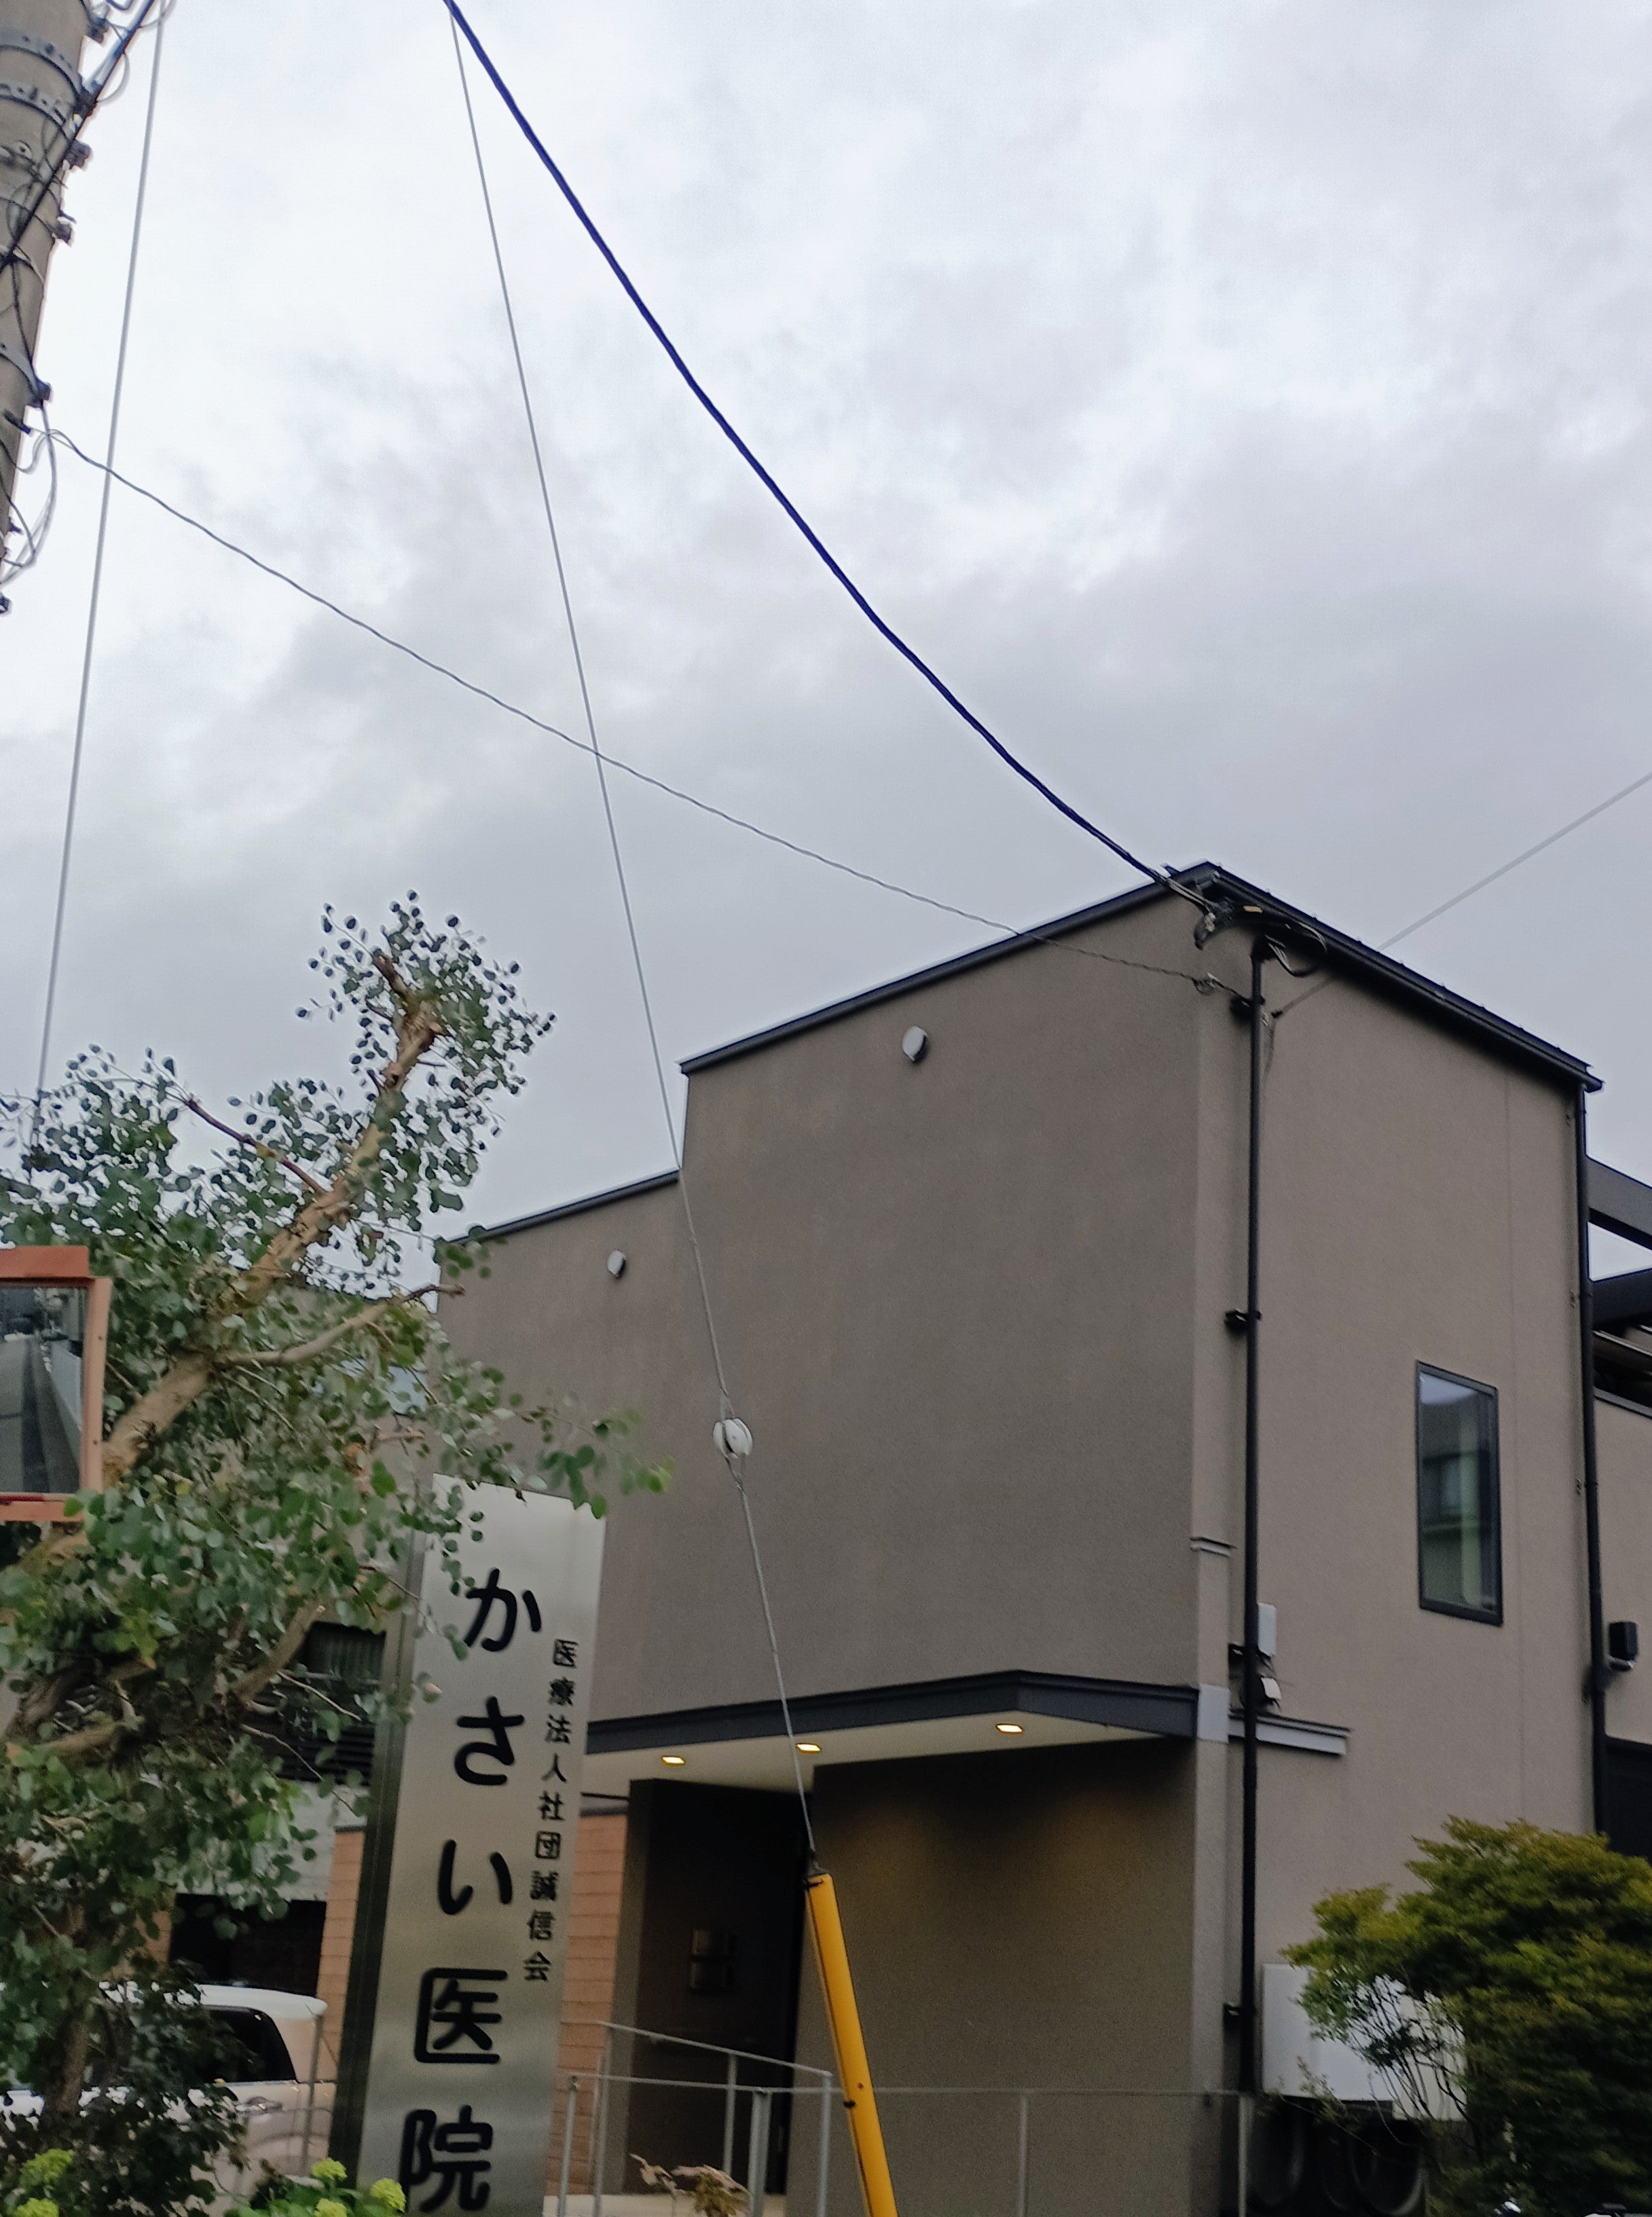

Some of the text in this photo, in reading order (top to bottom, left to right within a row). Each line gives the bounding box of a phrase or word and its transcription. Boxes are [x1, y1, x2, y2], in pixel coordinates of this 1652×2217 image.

[398, 1567, 542, 2213] かさい医院
[522, 1638, 579, 1983] 医療法人社団誠信会
